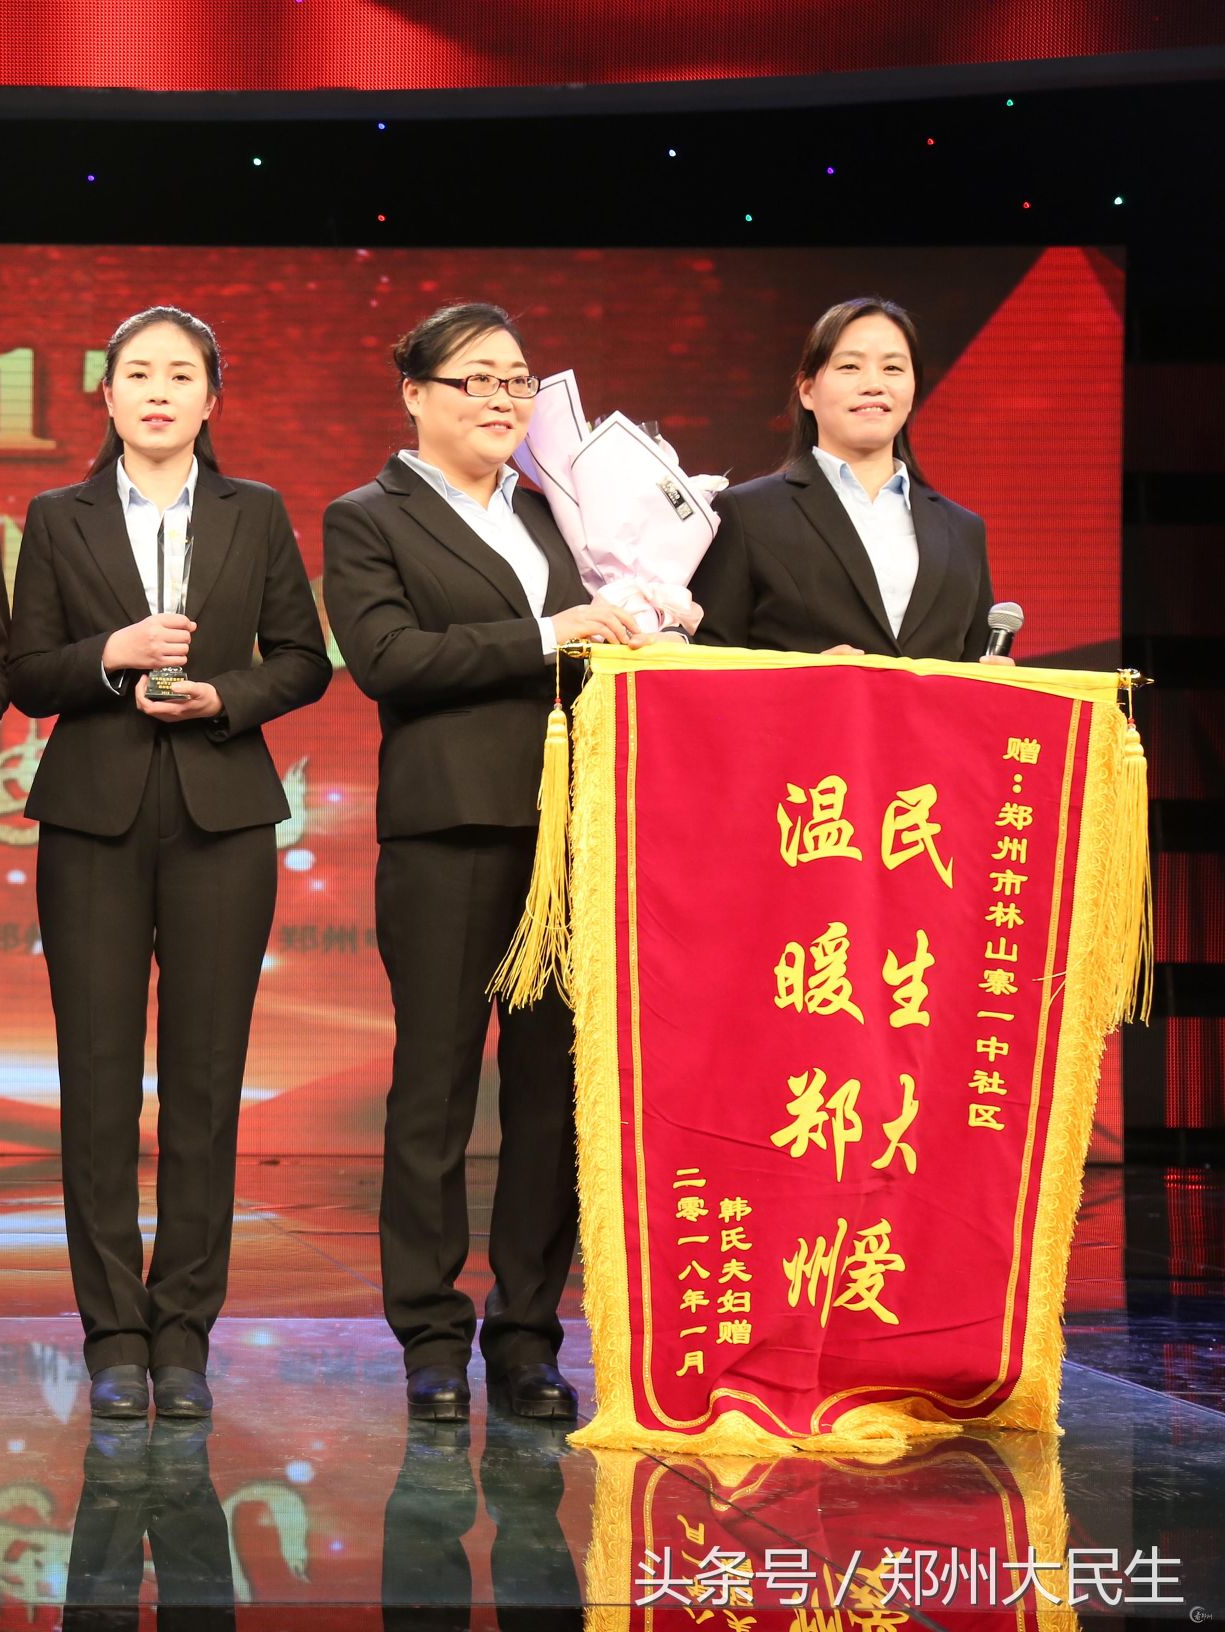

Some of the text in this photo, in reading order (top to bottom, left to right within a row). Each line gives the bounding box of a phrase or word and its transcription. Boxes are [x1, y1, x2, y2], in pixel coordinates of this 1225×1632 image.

[770, 774, 864, 1328] 温暖郑州
[831, 784, 954, 1325] 民生大爱
[672, 1168, 710, 1377] 二零一八年一月
[716, 1196, 753, 1345] 韩氏夫妇赠
